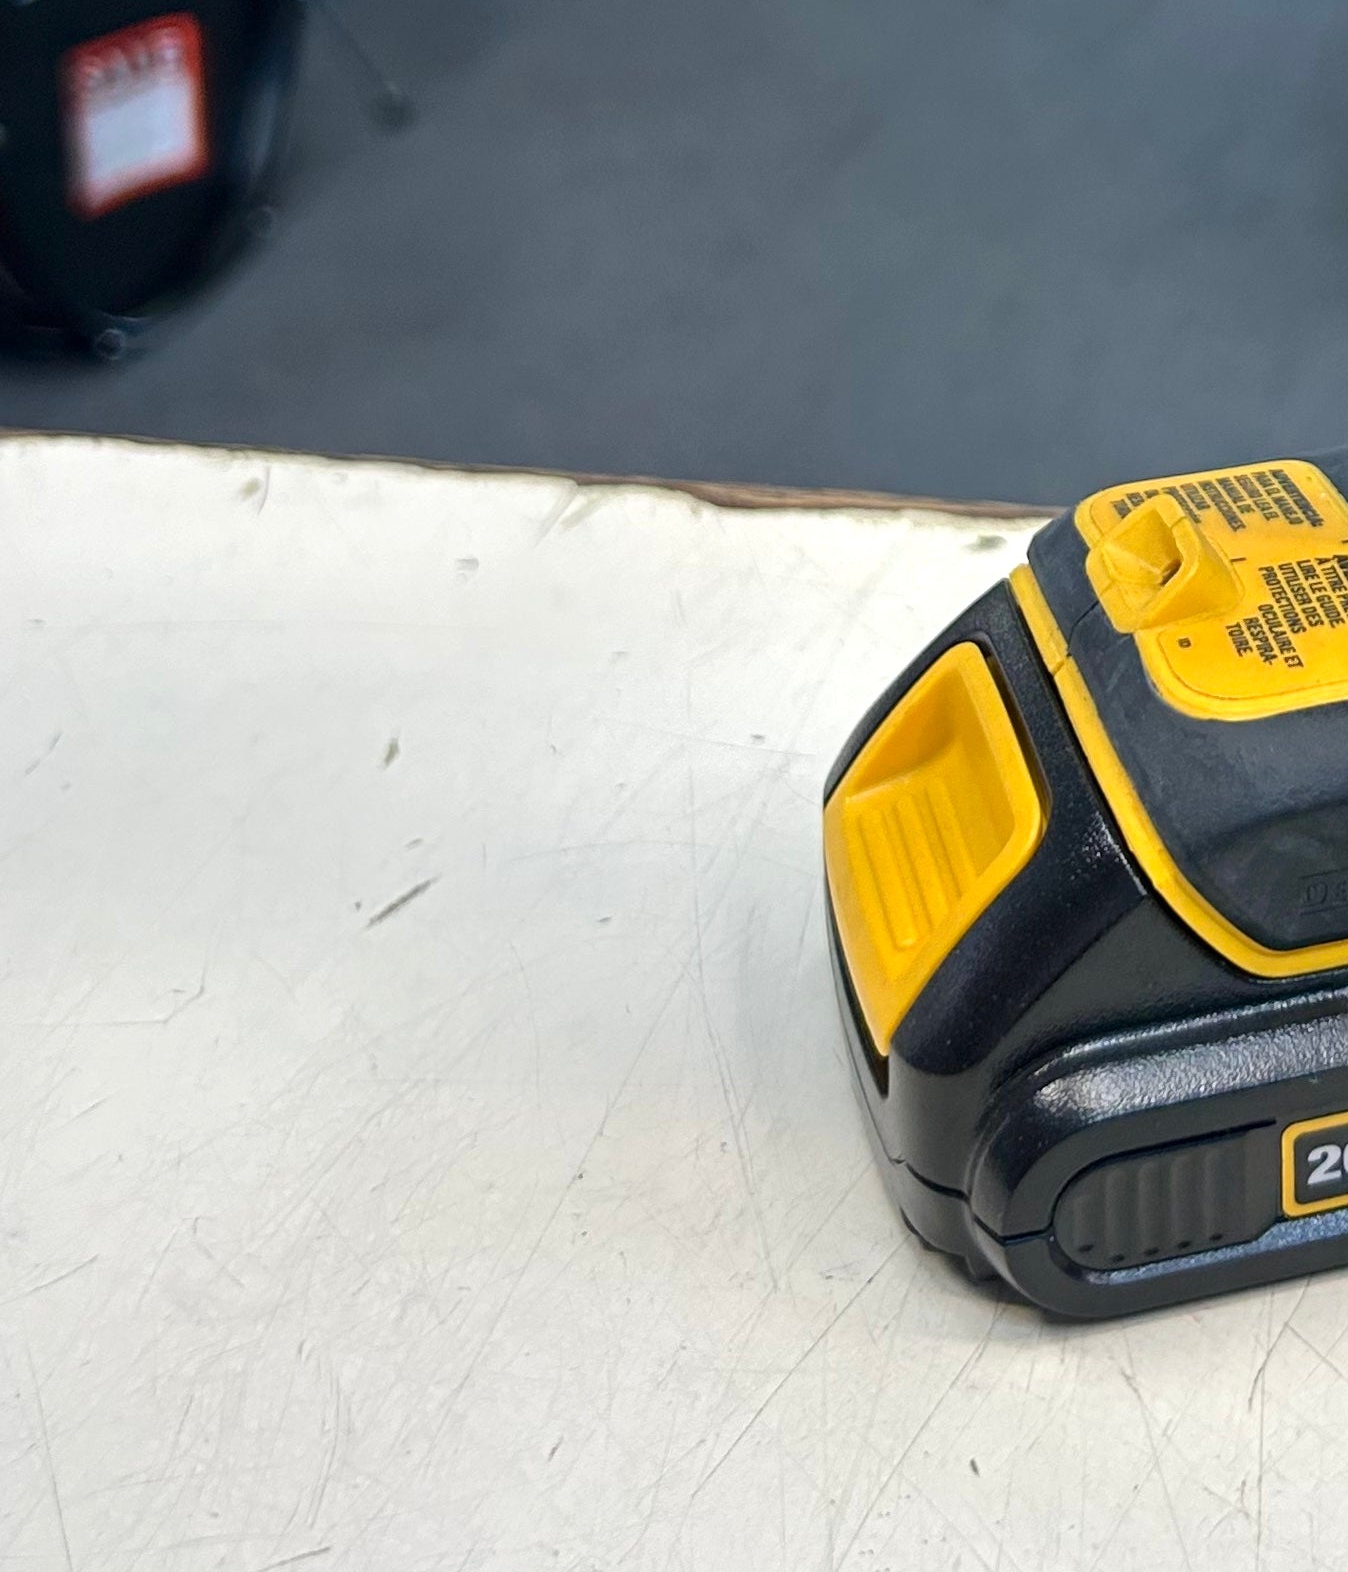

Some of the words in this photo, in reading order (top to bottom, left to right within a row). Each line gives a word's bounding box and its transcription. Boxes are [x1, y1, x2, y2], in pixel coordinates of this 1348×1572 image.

[1258, 566, 1307, 634] PROTECTIONS
[1278, 562, 1312, 605] UTILISER
[1301, 605, 1324, 627] DES
[1296, 559, 1320, 581] LIRE
[1309, 582, 1328, 594] LE
[1321, 565, 1347, 593] TITRE
[1258, 604, 1296, 654] OCULAIRE
[1284, 654, 1304, 668] ET
